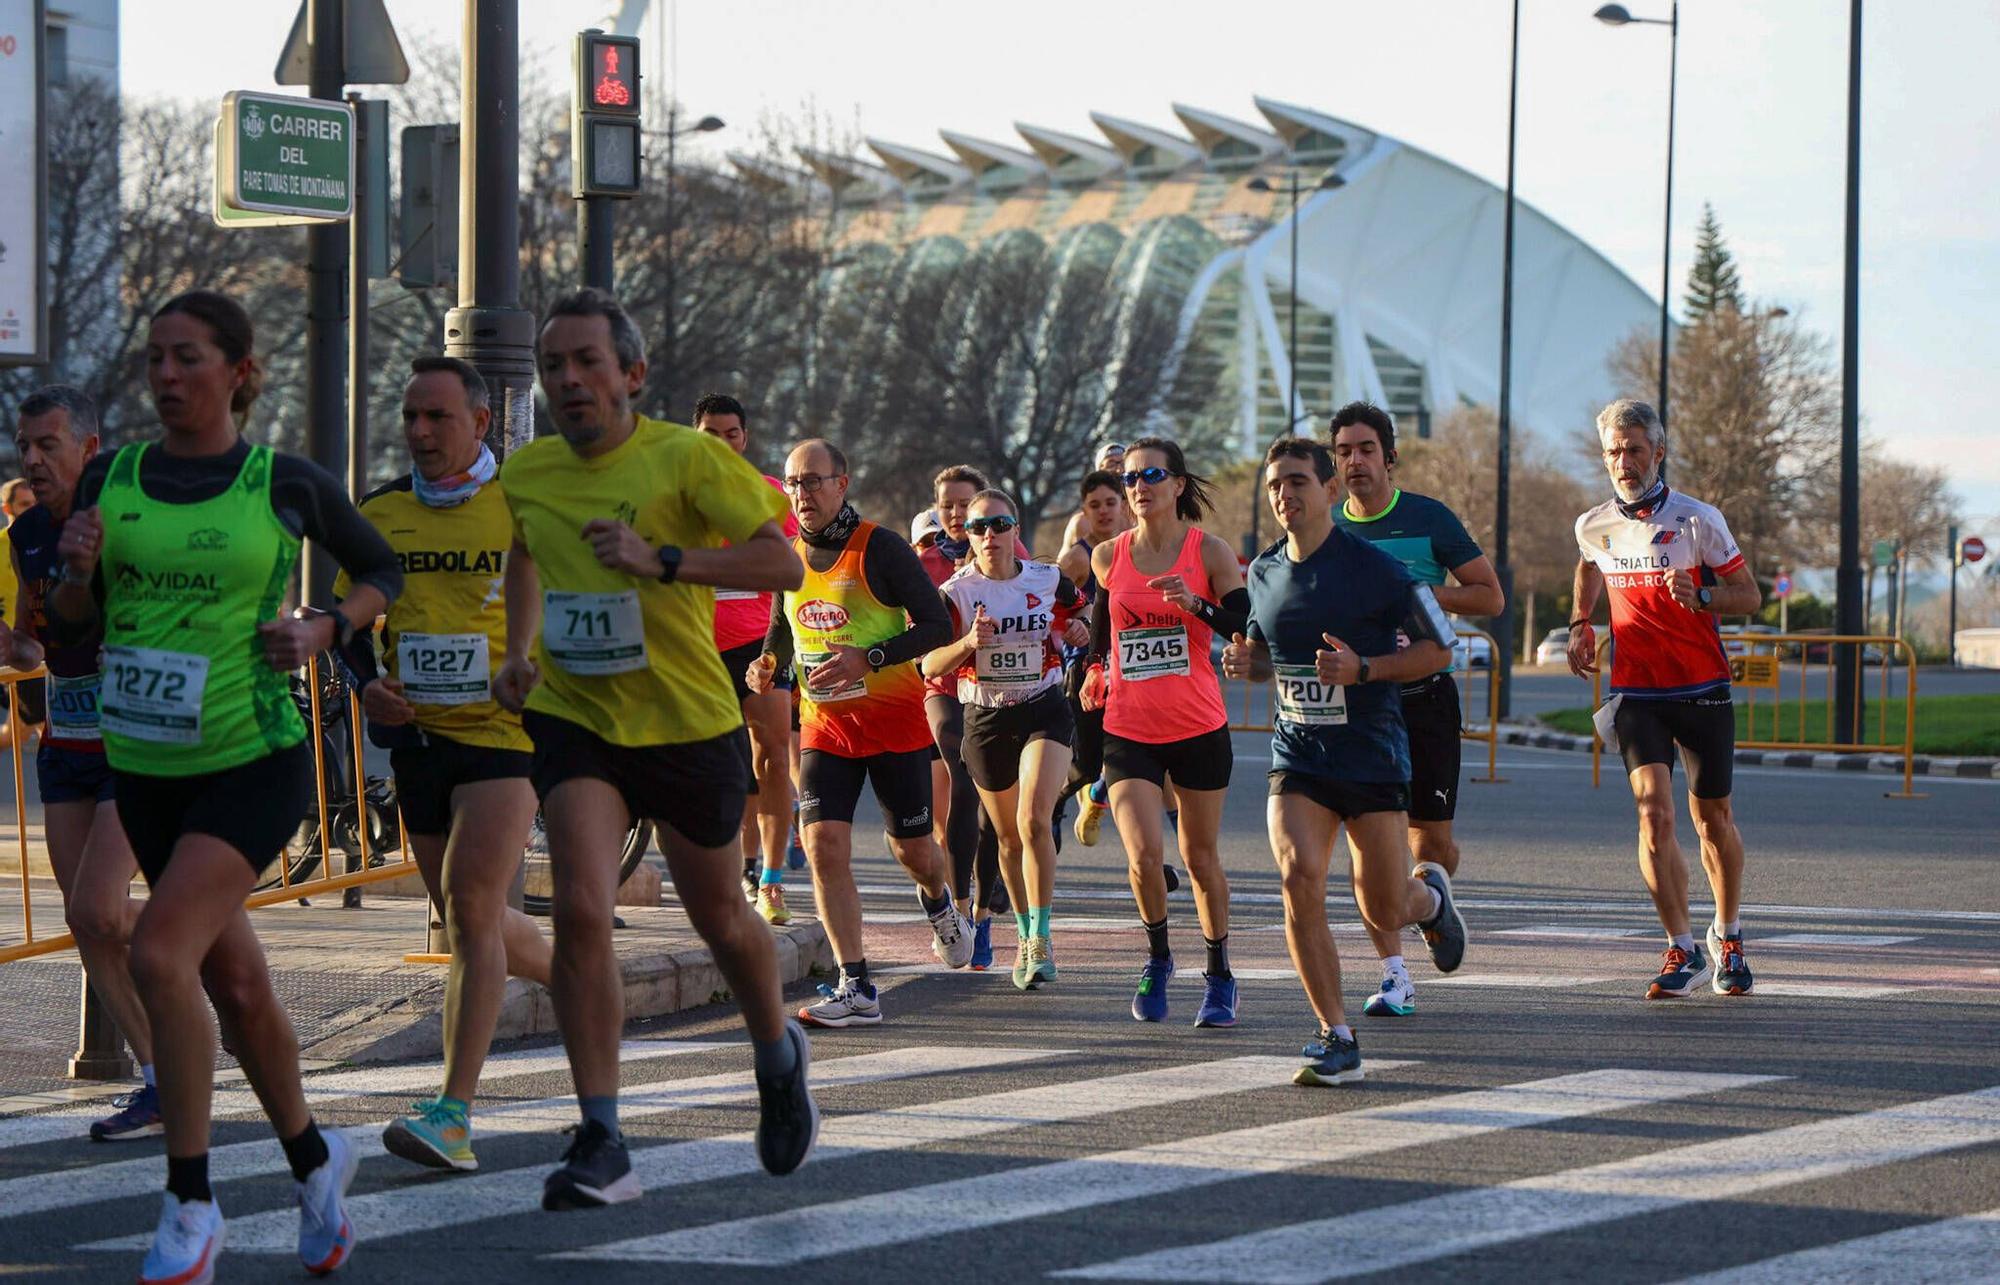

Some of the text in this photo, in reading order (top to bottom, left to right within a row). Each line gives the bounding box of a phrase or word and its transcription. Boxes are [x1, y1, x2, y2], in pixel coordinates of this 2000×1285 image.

[270, 114, 342, 141] CARRER
[280, 146, 308, 165] DEL
[243, 169, 262, 191] PARE
[289, 175, 300, 195] DE
[300, 174, 346, 200] MONTAÑANA
[1613, 553, 1670, 569] TRIATLÓ
[147, 572, 221, 591] VIDAL
[1607, 574, 1664, 588] RIBA-RO
[565, 609, 611, 637] 711
[802, 609, 844, 622] Serrano
[1146, 612, 1182, 626] Delta
[833, 633, 854, 642] CORRE
[408, 648, 475, 672] 1227
[990, 652, 1027, 667] 891
[1122, 638, 1183, 663] 7345
[115, 664, 187, 702] 1272
[1279, 679, 1336, 703] 7207
